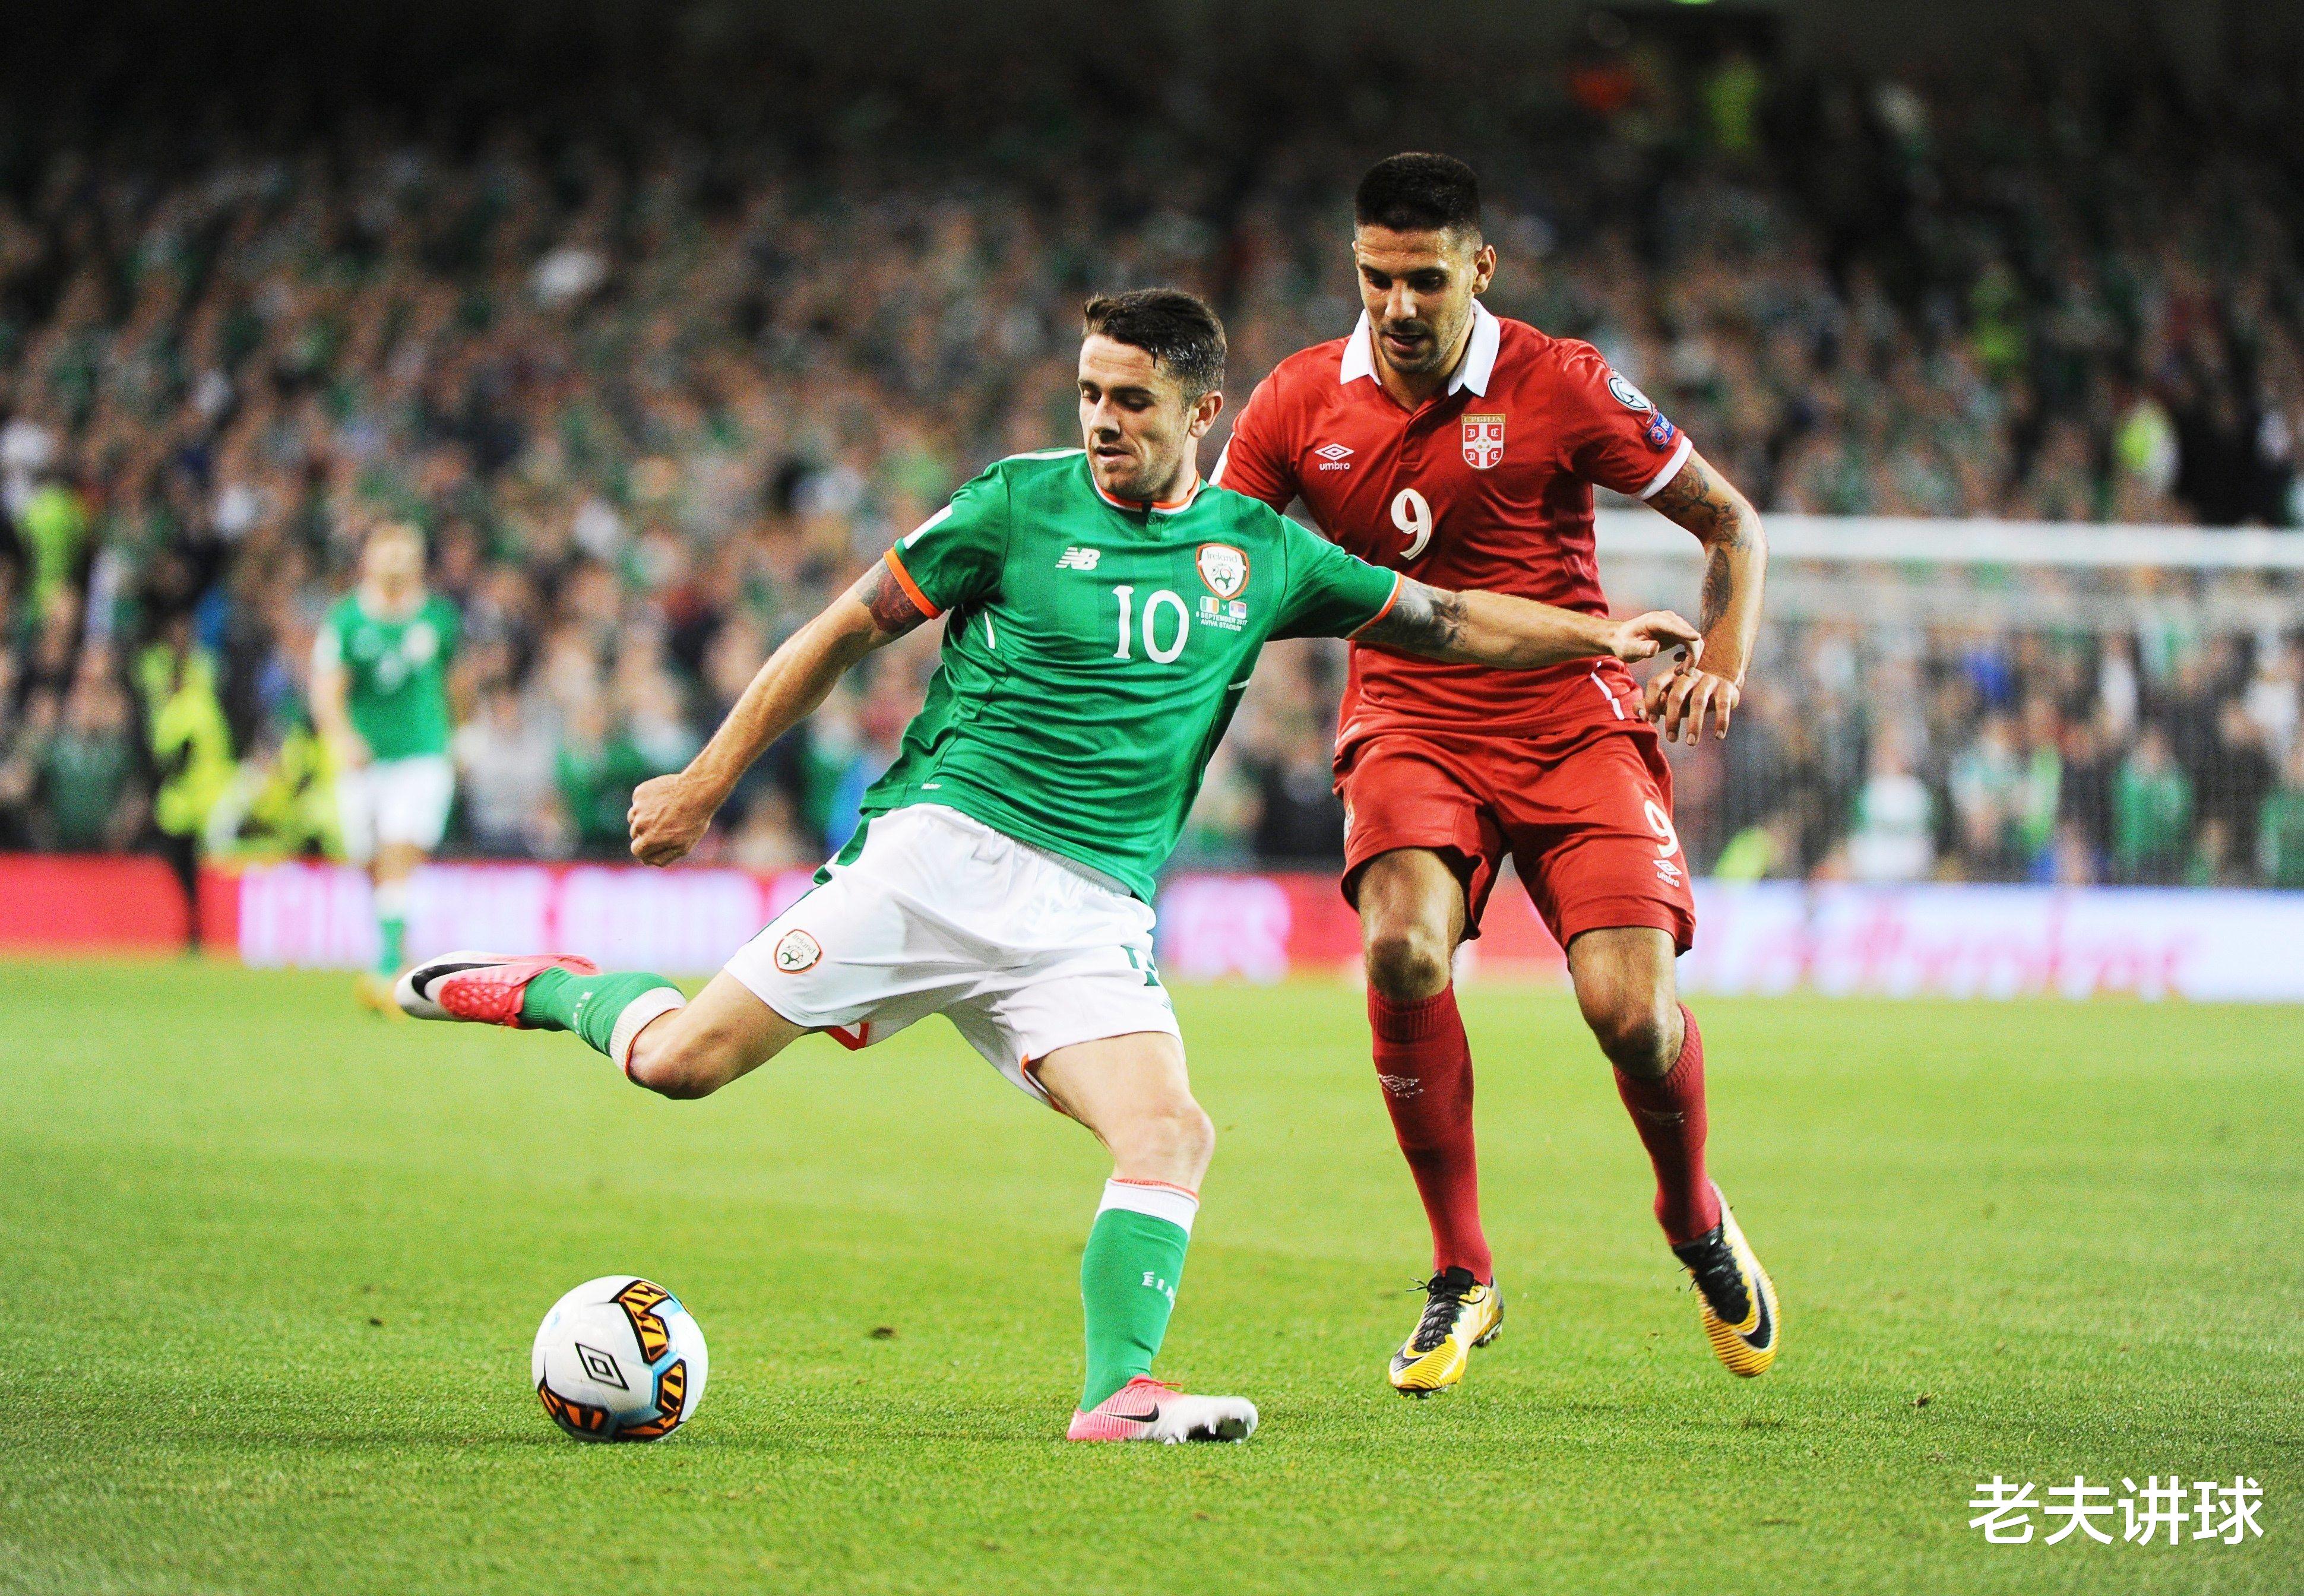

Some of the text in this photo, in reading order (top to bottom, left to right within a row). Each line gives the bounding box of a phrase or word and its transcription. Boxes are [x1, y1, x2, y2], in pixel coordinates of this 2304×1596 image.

[1319, 461, 1350, 470] umbro
[1391, 488, 1432, 560] 9
[1207, 550, 1238, 563] Ireland
[1112, 585, 1190, 664] 10
[1200, 618, 1219, 627] AVIVA
[1644, 799, 1679, 859] 9
[1657, 871, 1680, 887] umbro
